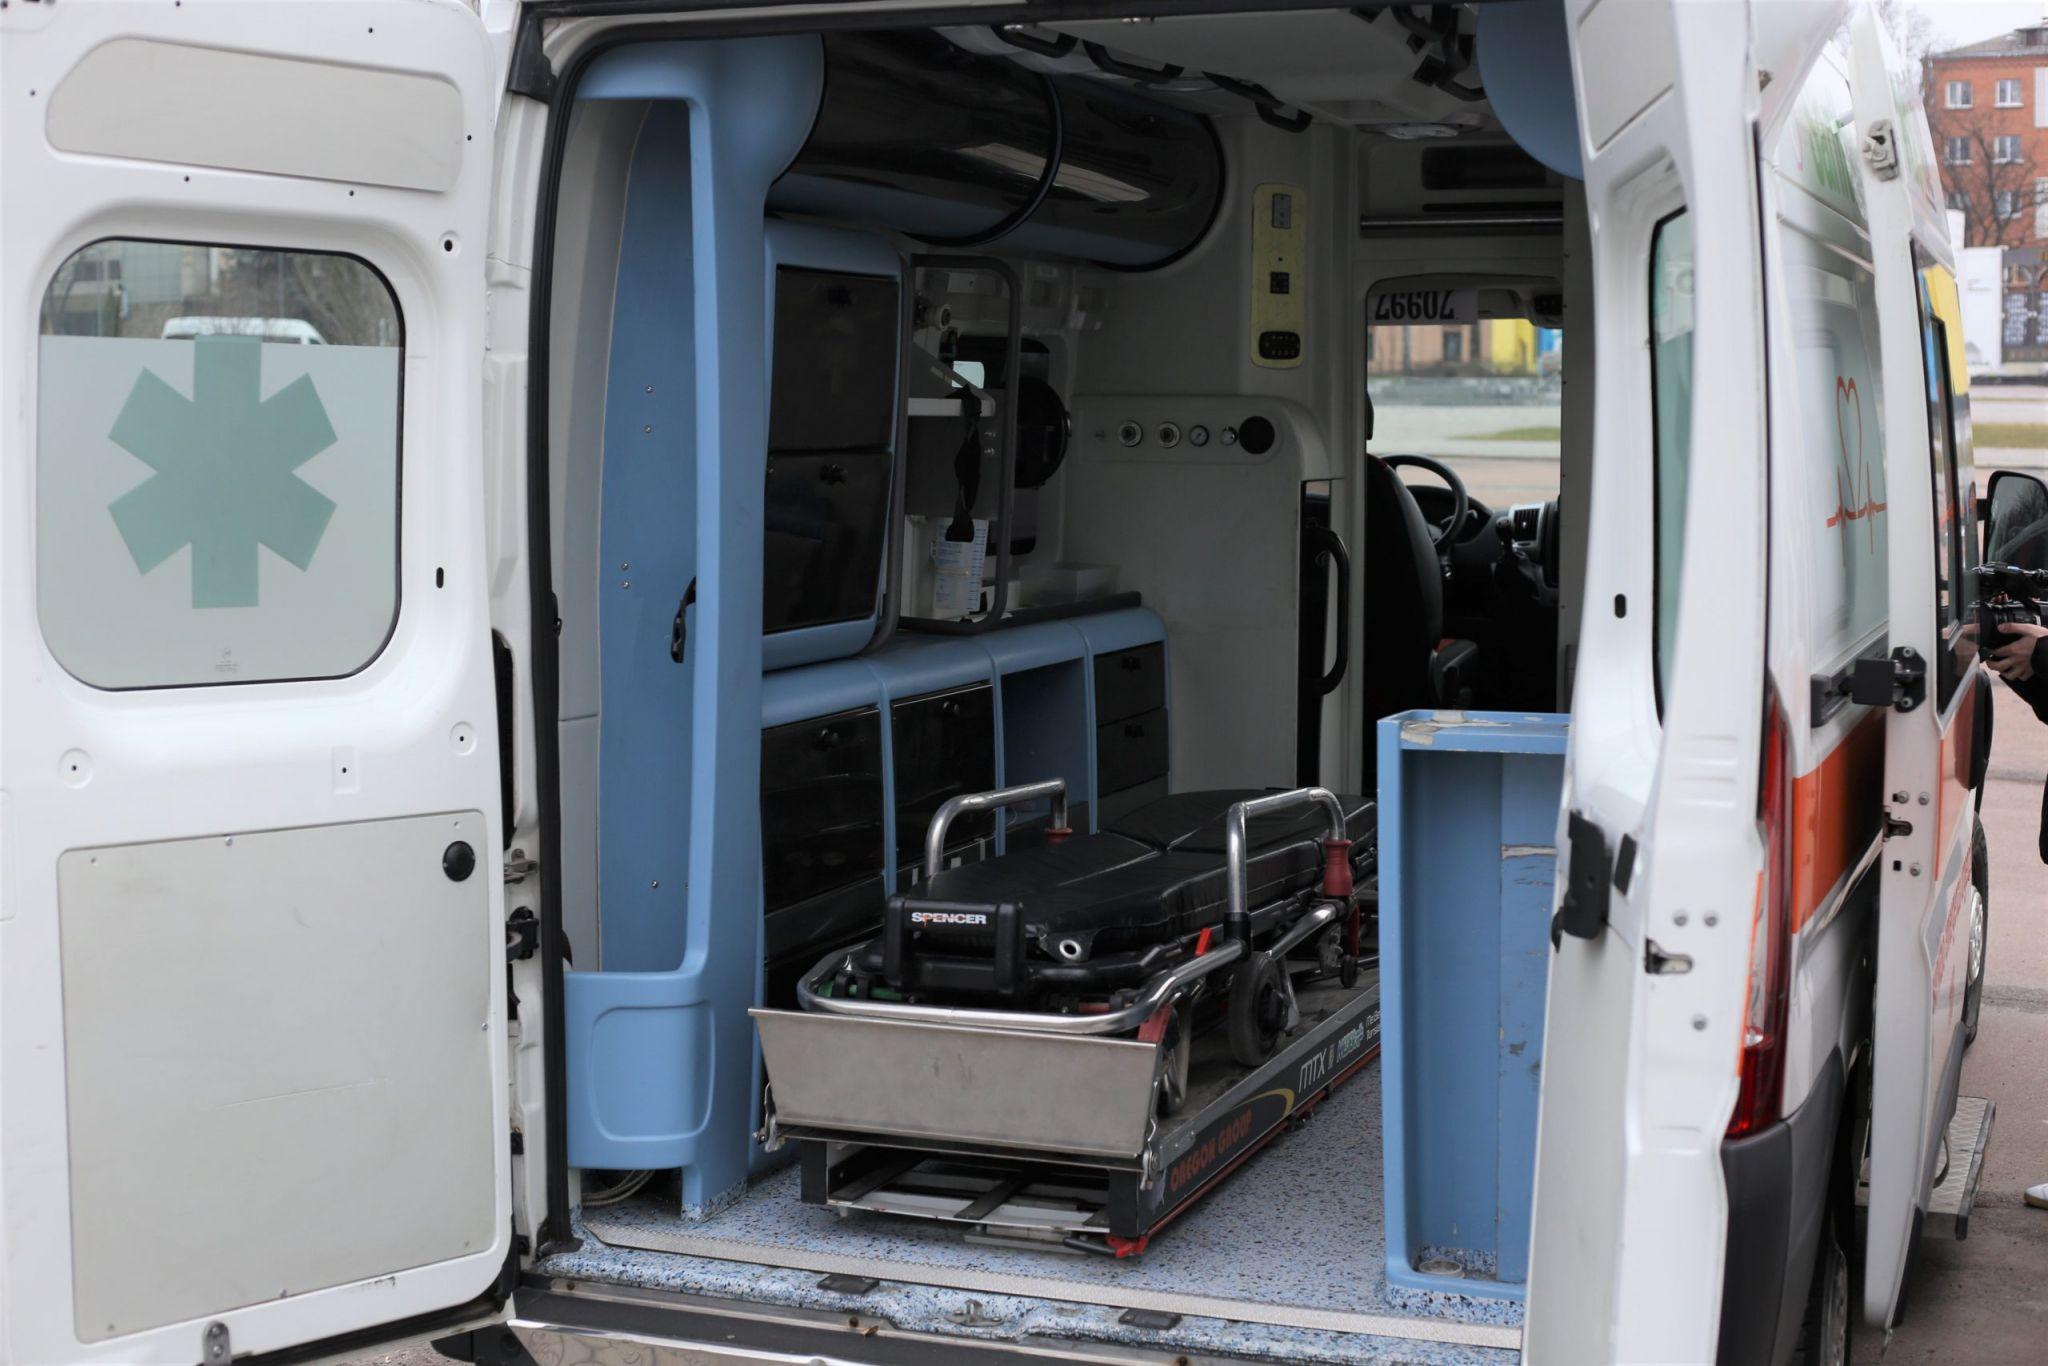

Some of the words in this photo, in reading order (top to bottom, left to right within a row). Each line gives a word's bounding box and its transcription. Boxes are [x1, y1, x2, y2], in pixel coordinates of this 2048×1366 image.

[911, 911, 987, 925] SPENCER
[1298, 1048, 1327, 1094] MTX
[1170, 1137, 1216, 1193] OREGON
[1218, 1107, 1254, 1154] GROUP
